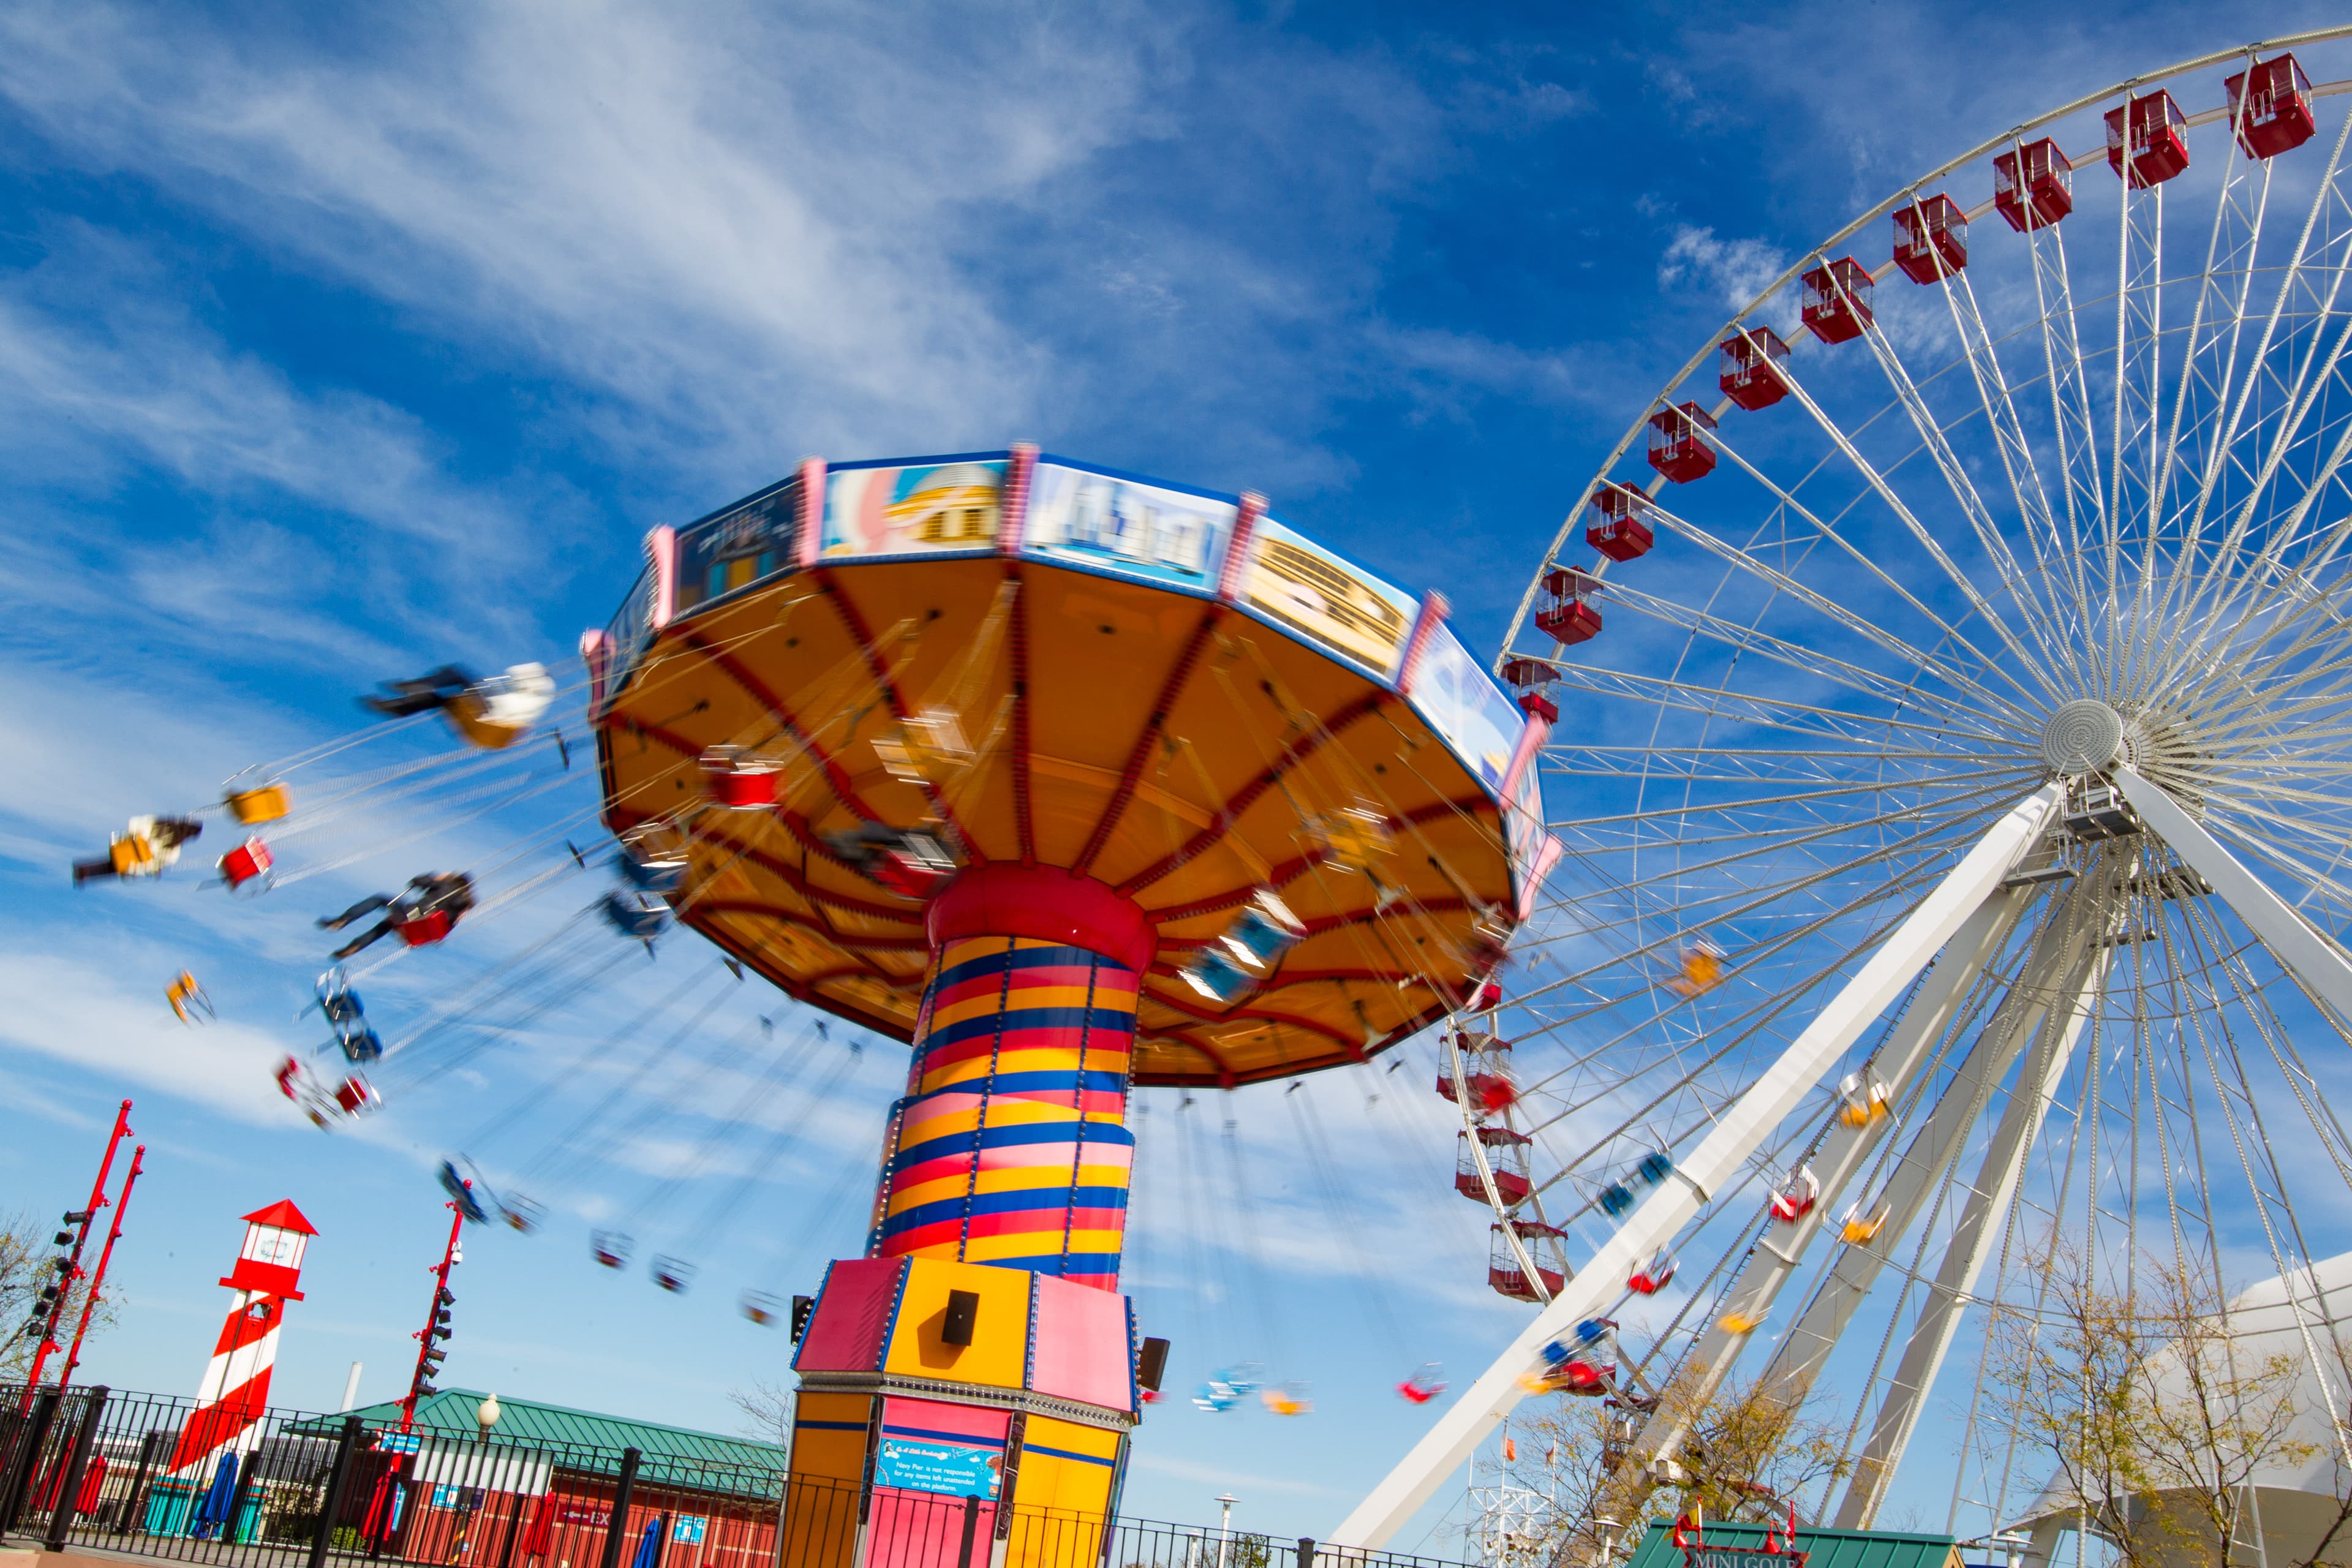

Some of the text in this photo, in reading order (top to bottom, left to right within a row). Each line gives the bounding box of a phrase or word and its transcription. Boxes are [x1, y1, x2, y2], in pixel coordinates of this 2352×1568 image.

[896, 1461, 911, 1470] Navy
[590, 1511, 610, 1525] EX
[1695, 1553, 1740, 1568] MINI
